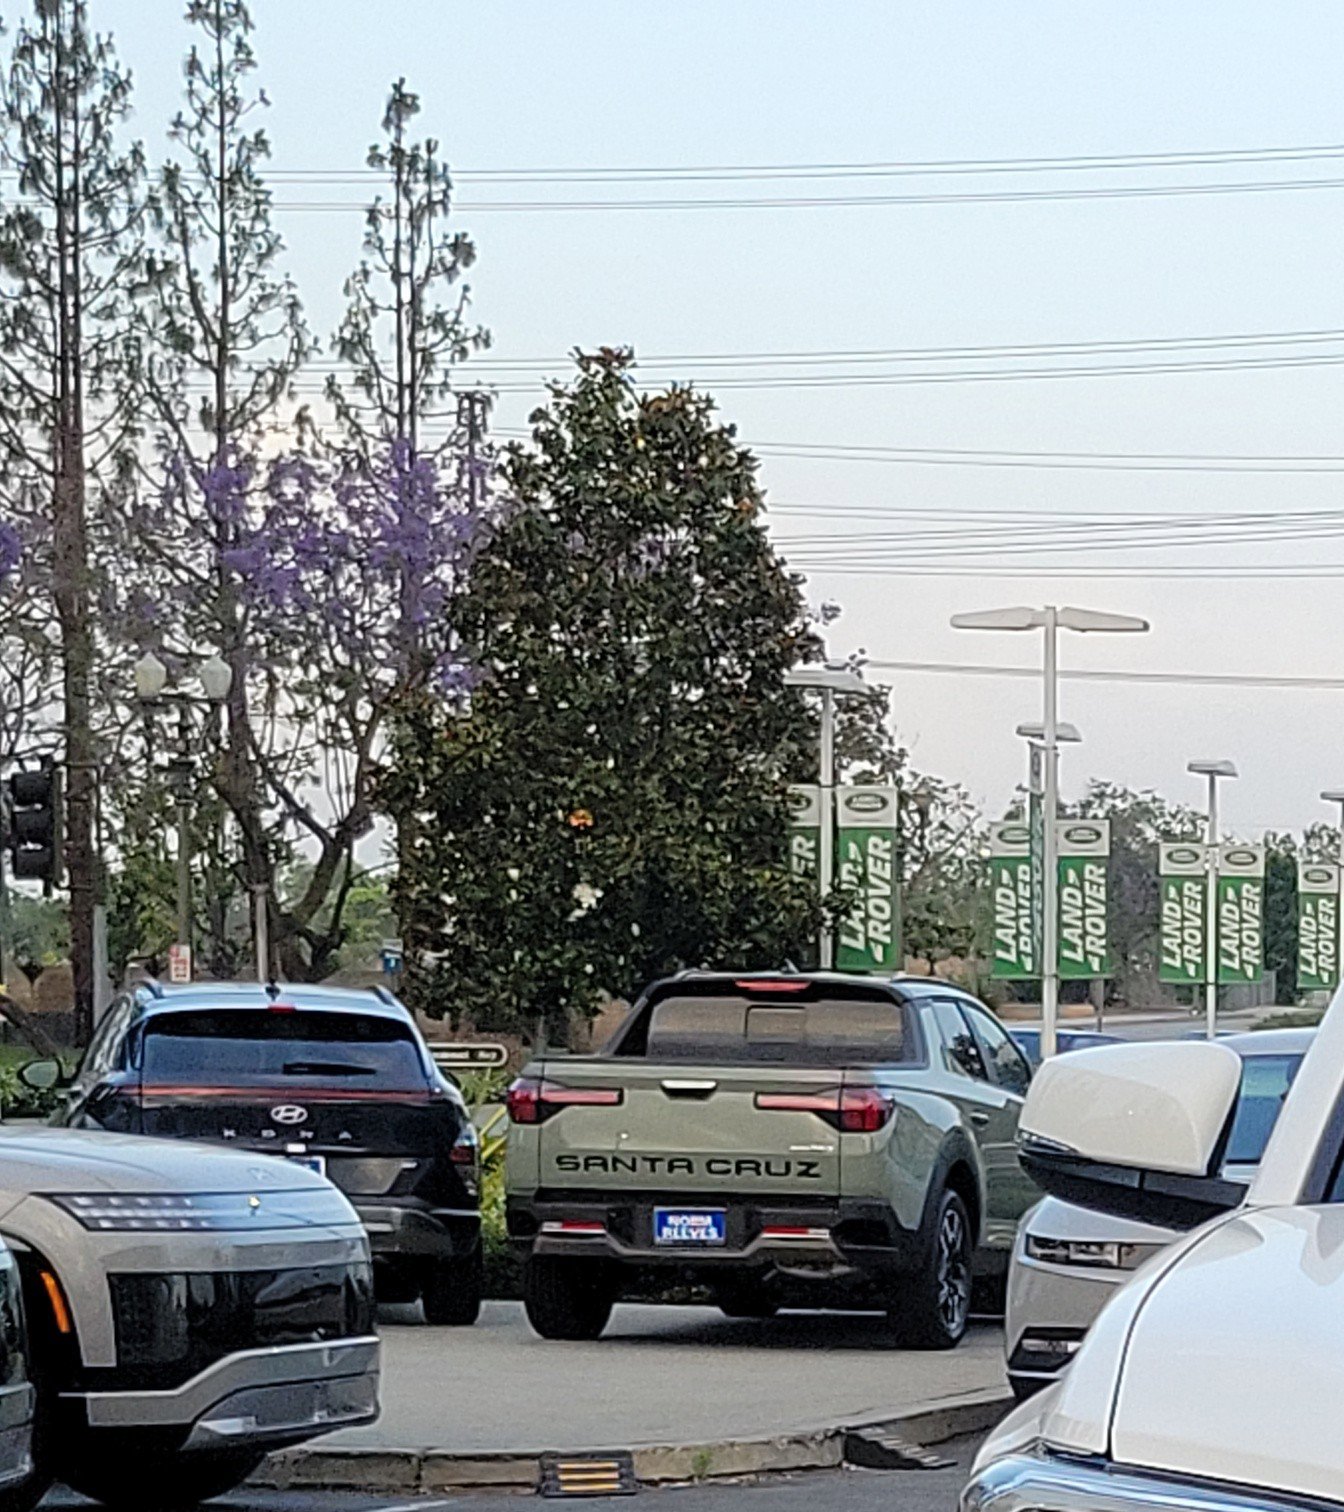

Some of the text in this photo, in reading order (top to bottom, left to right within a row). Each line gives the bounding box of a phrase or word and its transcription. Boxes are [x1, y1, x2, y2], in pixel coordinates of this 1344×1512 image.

[868, 835, 892, 945] ROVER
[995, 887, 1017, 963] LAND
[1062, 887, 1084, 963] LAND
[1084, 863, 1107, 956] ROVER
[1183, 881, 1203, 964] ROVER
[1241, 882, 1261, 965] ROVER
[1162, 900, 1182, 968] LAND
[1220, 902, 1240, 970] LAND
[1299, 916, 1317, 976] LAND
[1318, 899, 1336, 972] ROVER
[556, 1155, 822, 1179] SANTA CRUZ
